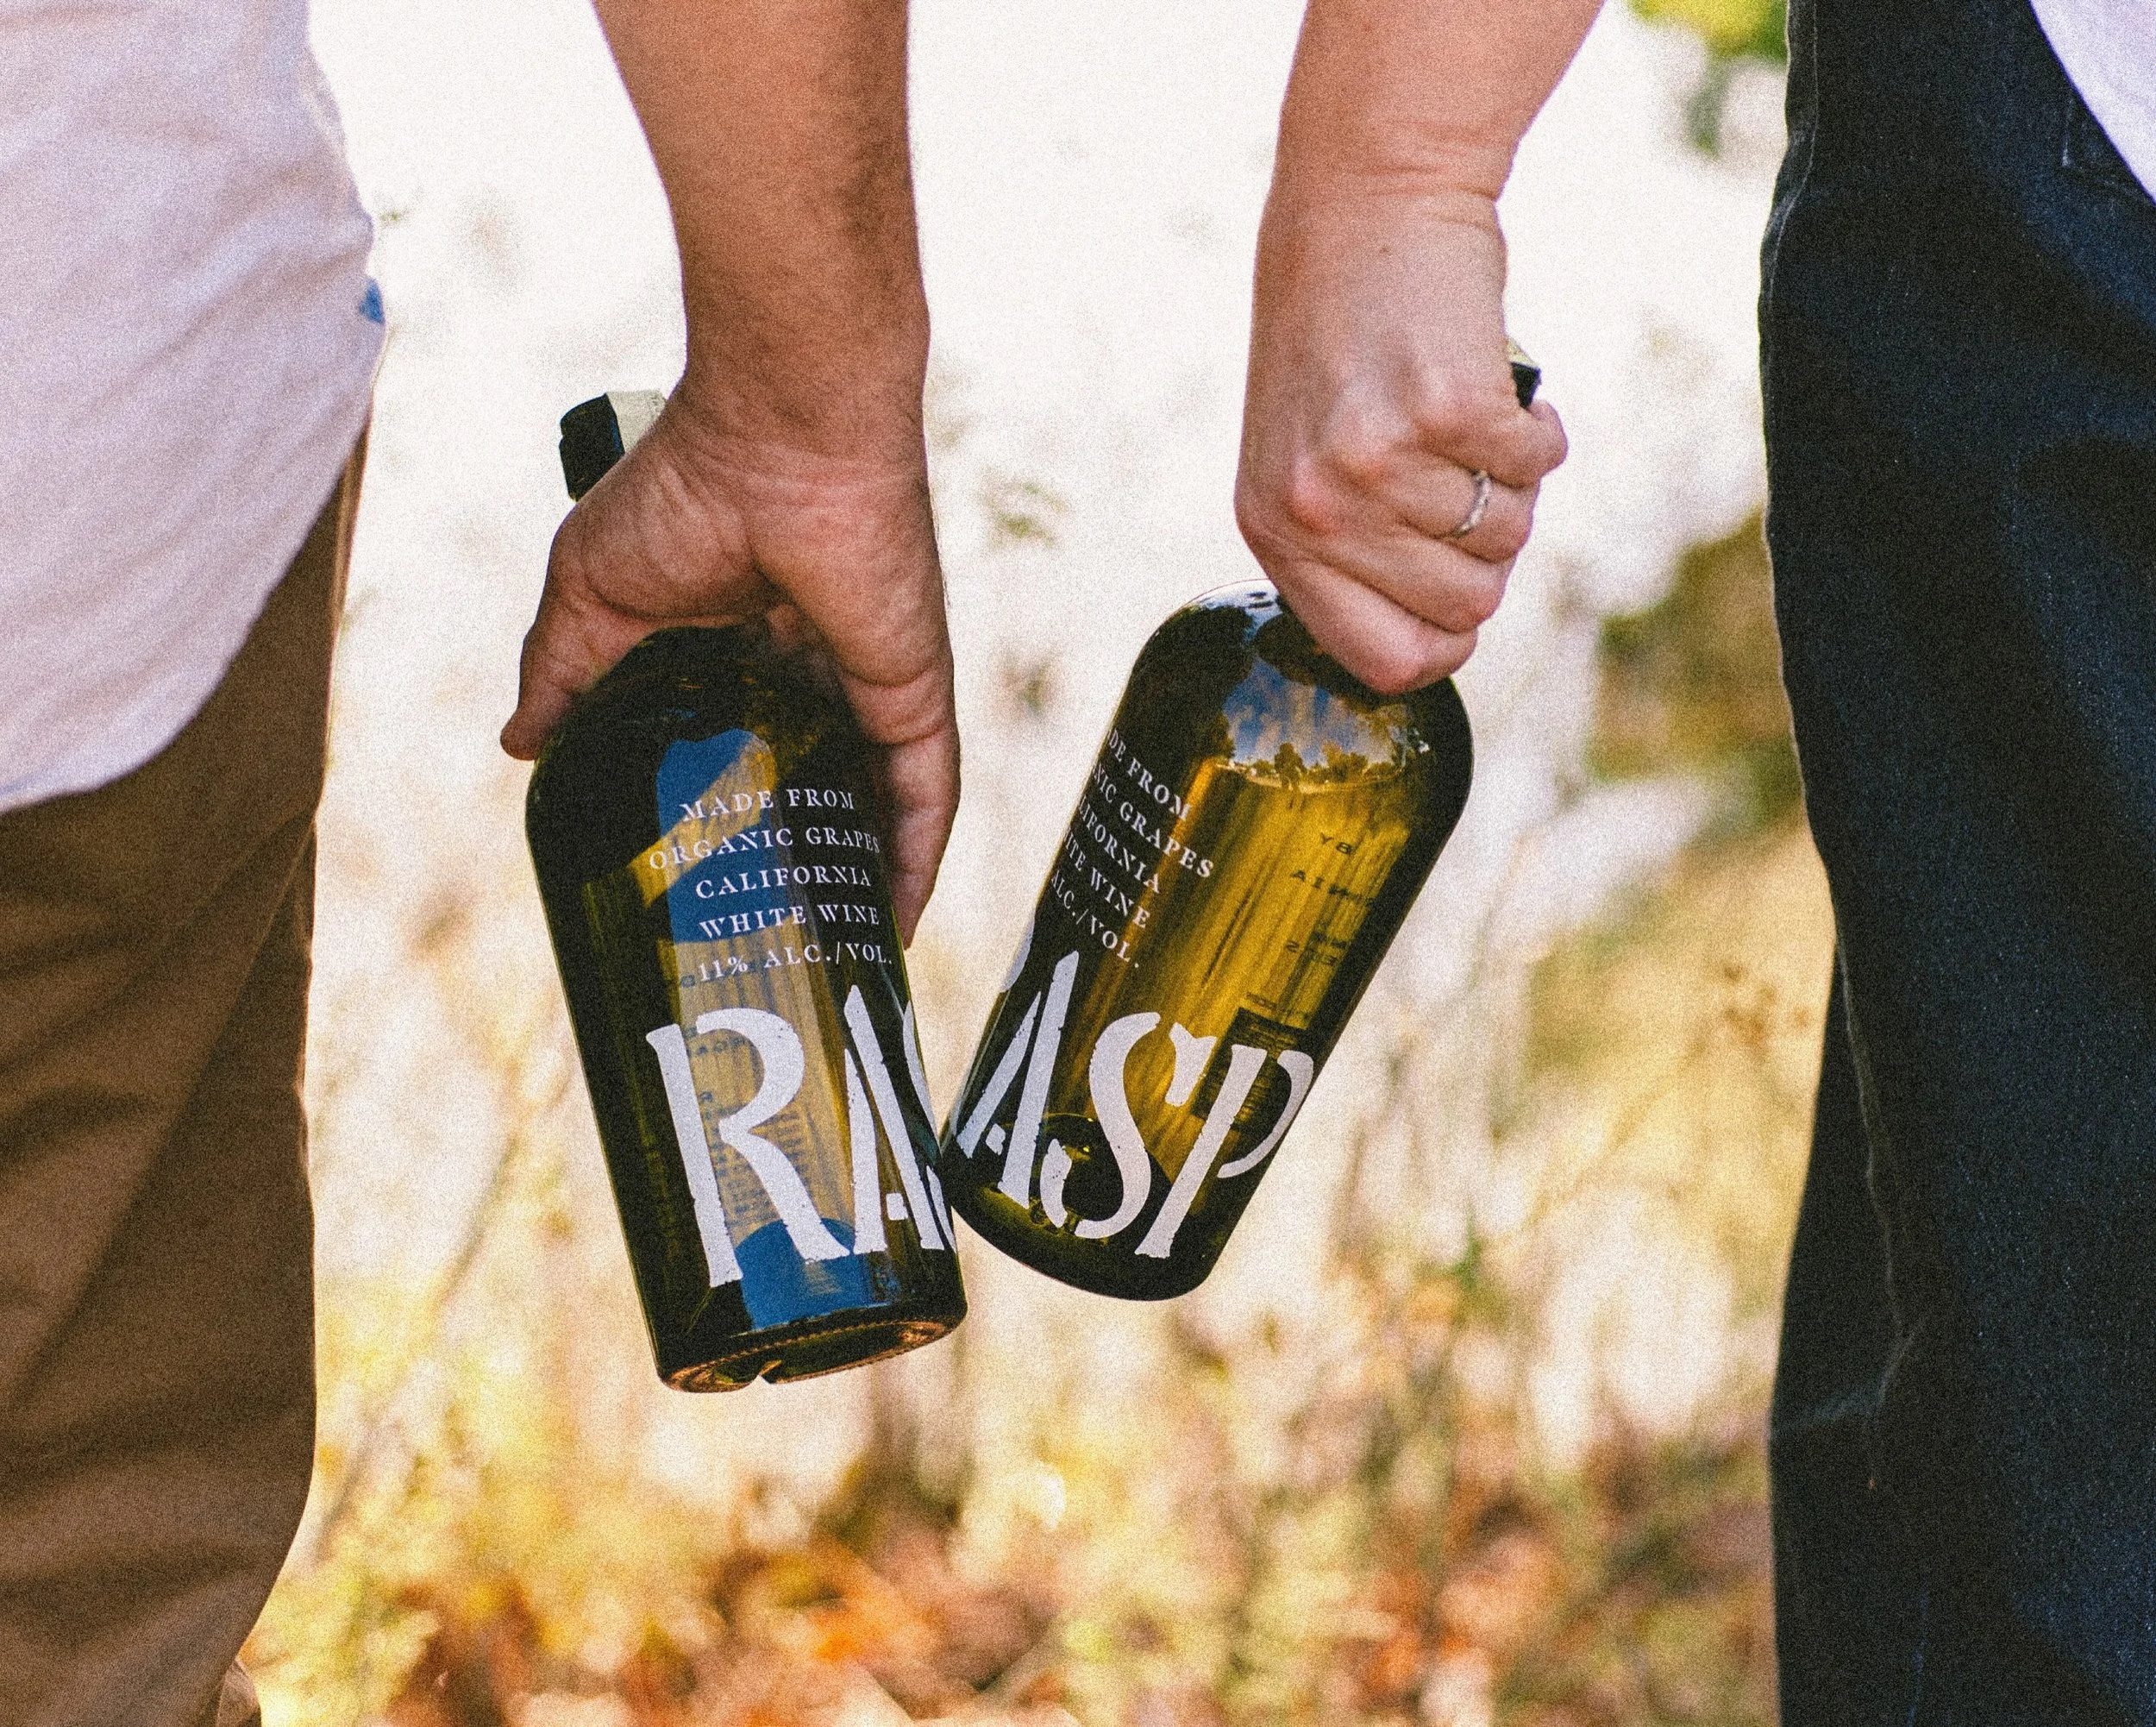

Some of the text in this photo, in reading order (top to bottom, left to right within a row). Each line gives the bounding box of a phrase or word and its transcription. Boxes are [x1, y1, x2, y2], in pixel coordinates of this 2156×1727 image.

[680, 788, 854, 822] MADE FROM
[1107, 729, 1191, 821] DE FROM
[649, 827, 880, 870] ORGANIC GRAPES
[1079, 794, 1160, 894] LIFORNIA
[1120, 801, 1213, 878] GRAPES
[695, 866, 871, 899] CALIFORNIA
[1063, 827, 1150, 929] ITE WINE
[699, 904, 880, 939] WHITE WINE
[697, 955, 749, 982] 11%
[949, 920, 1315, 1259] ASP
